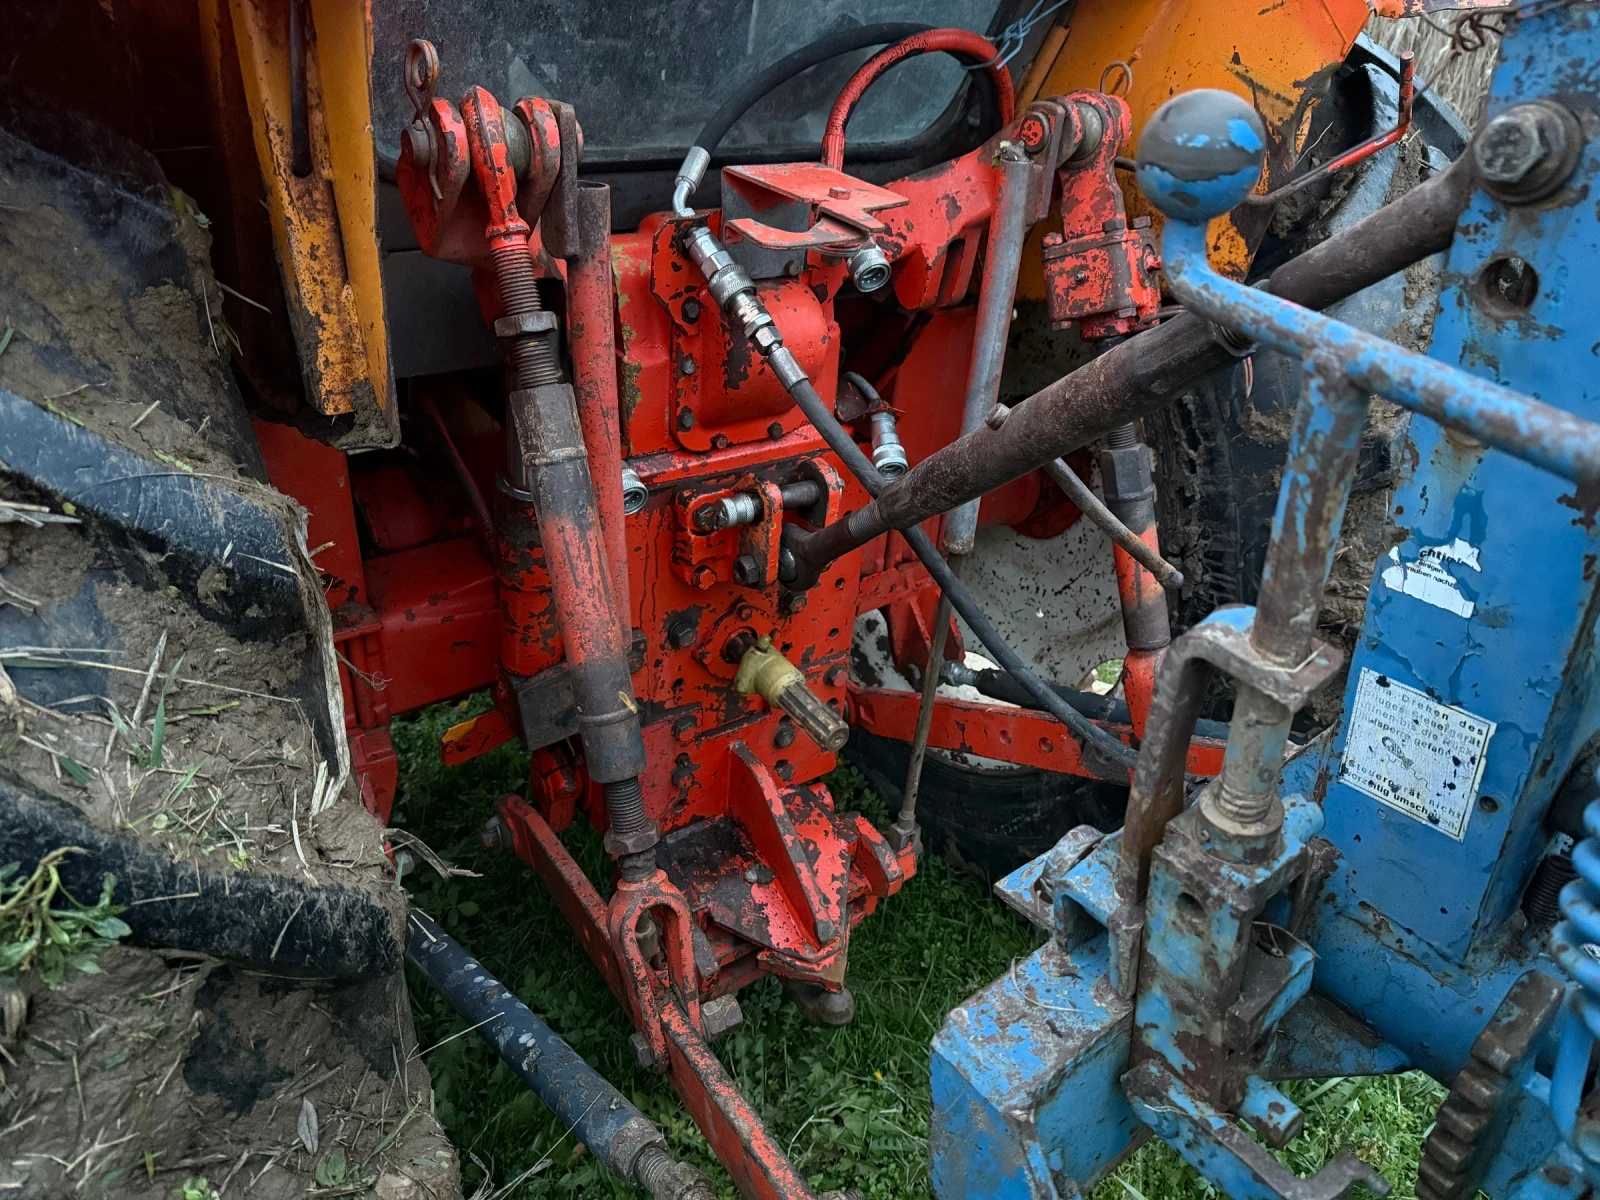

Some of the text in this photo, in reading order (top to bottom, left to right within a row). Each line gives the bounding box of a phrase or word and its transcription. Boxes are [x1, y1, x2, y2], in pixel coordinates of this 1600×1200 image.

[1418, 560, 1444, 574] einigen
[1401, 694, 1449, 720] Drehen
[1458, 718, 1484, 736] des
[1399, 718, 1417, 731] bis
[1421, 727, 1438, 741] die
[1428, 800, 1461, 819] nicht
